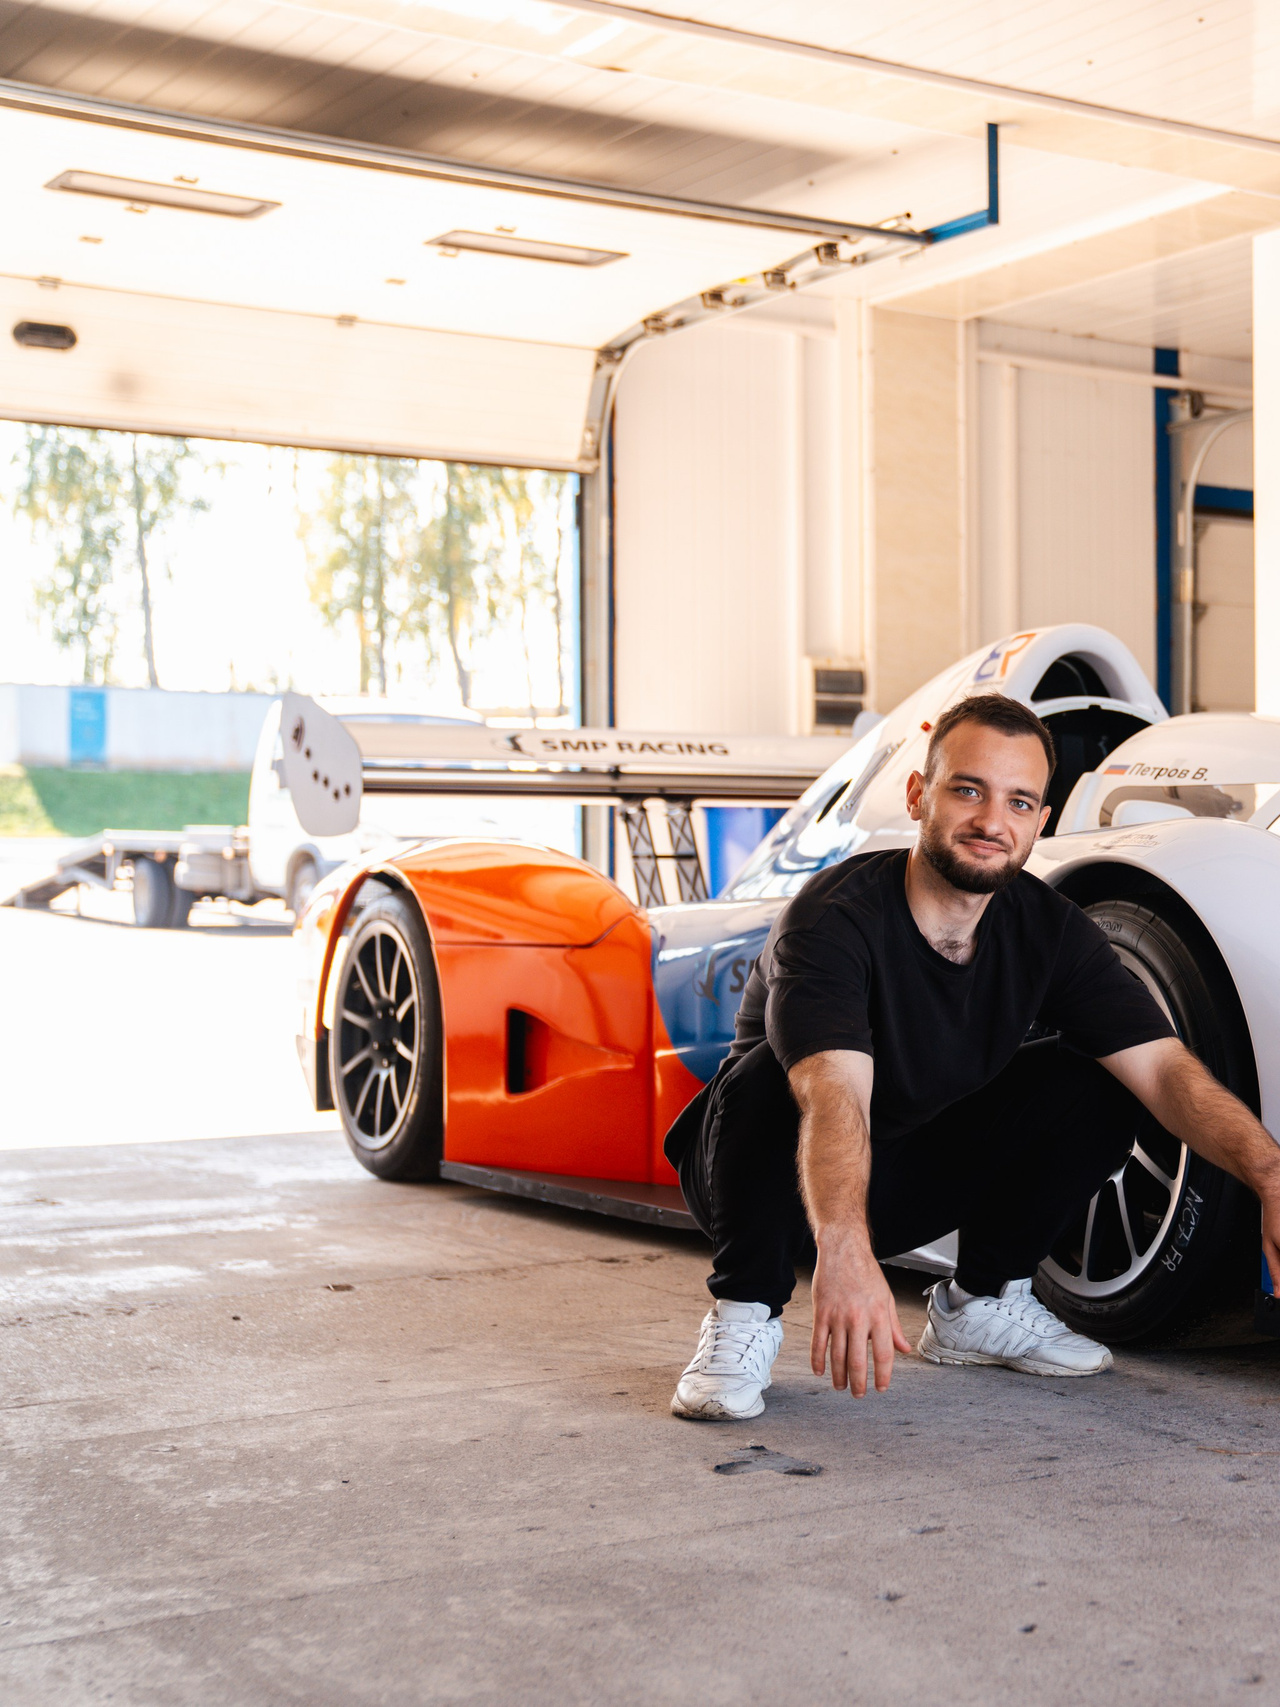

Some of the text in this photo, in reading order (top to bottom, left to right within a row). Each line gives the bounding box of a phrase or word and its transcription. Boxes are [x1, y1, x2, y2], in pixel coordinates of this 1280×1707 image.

[541, 738, 730, 756] SMP RACING
[1128, 762, 1190, 780] Петров
